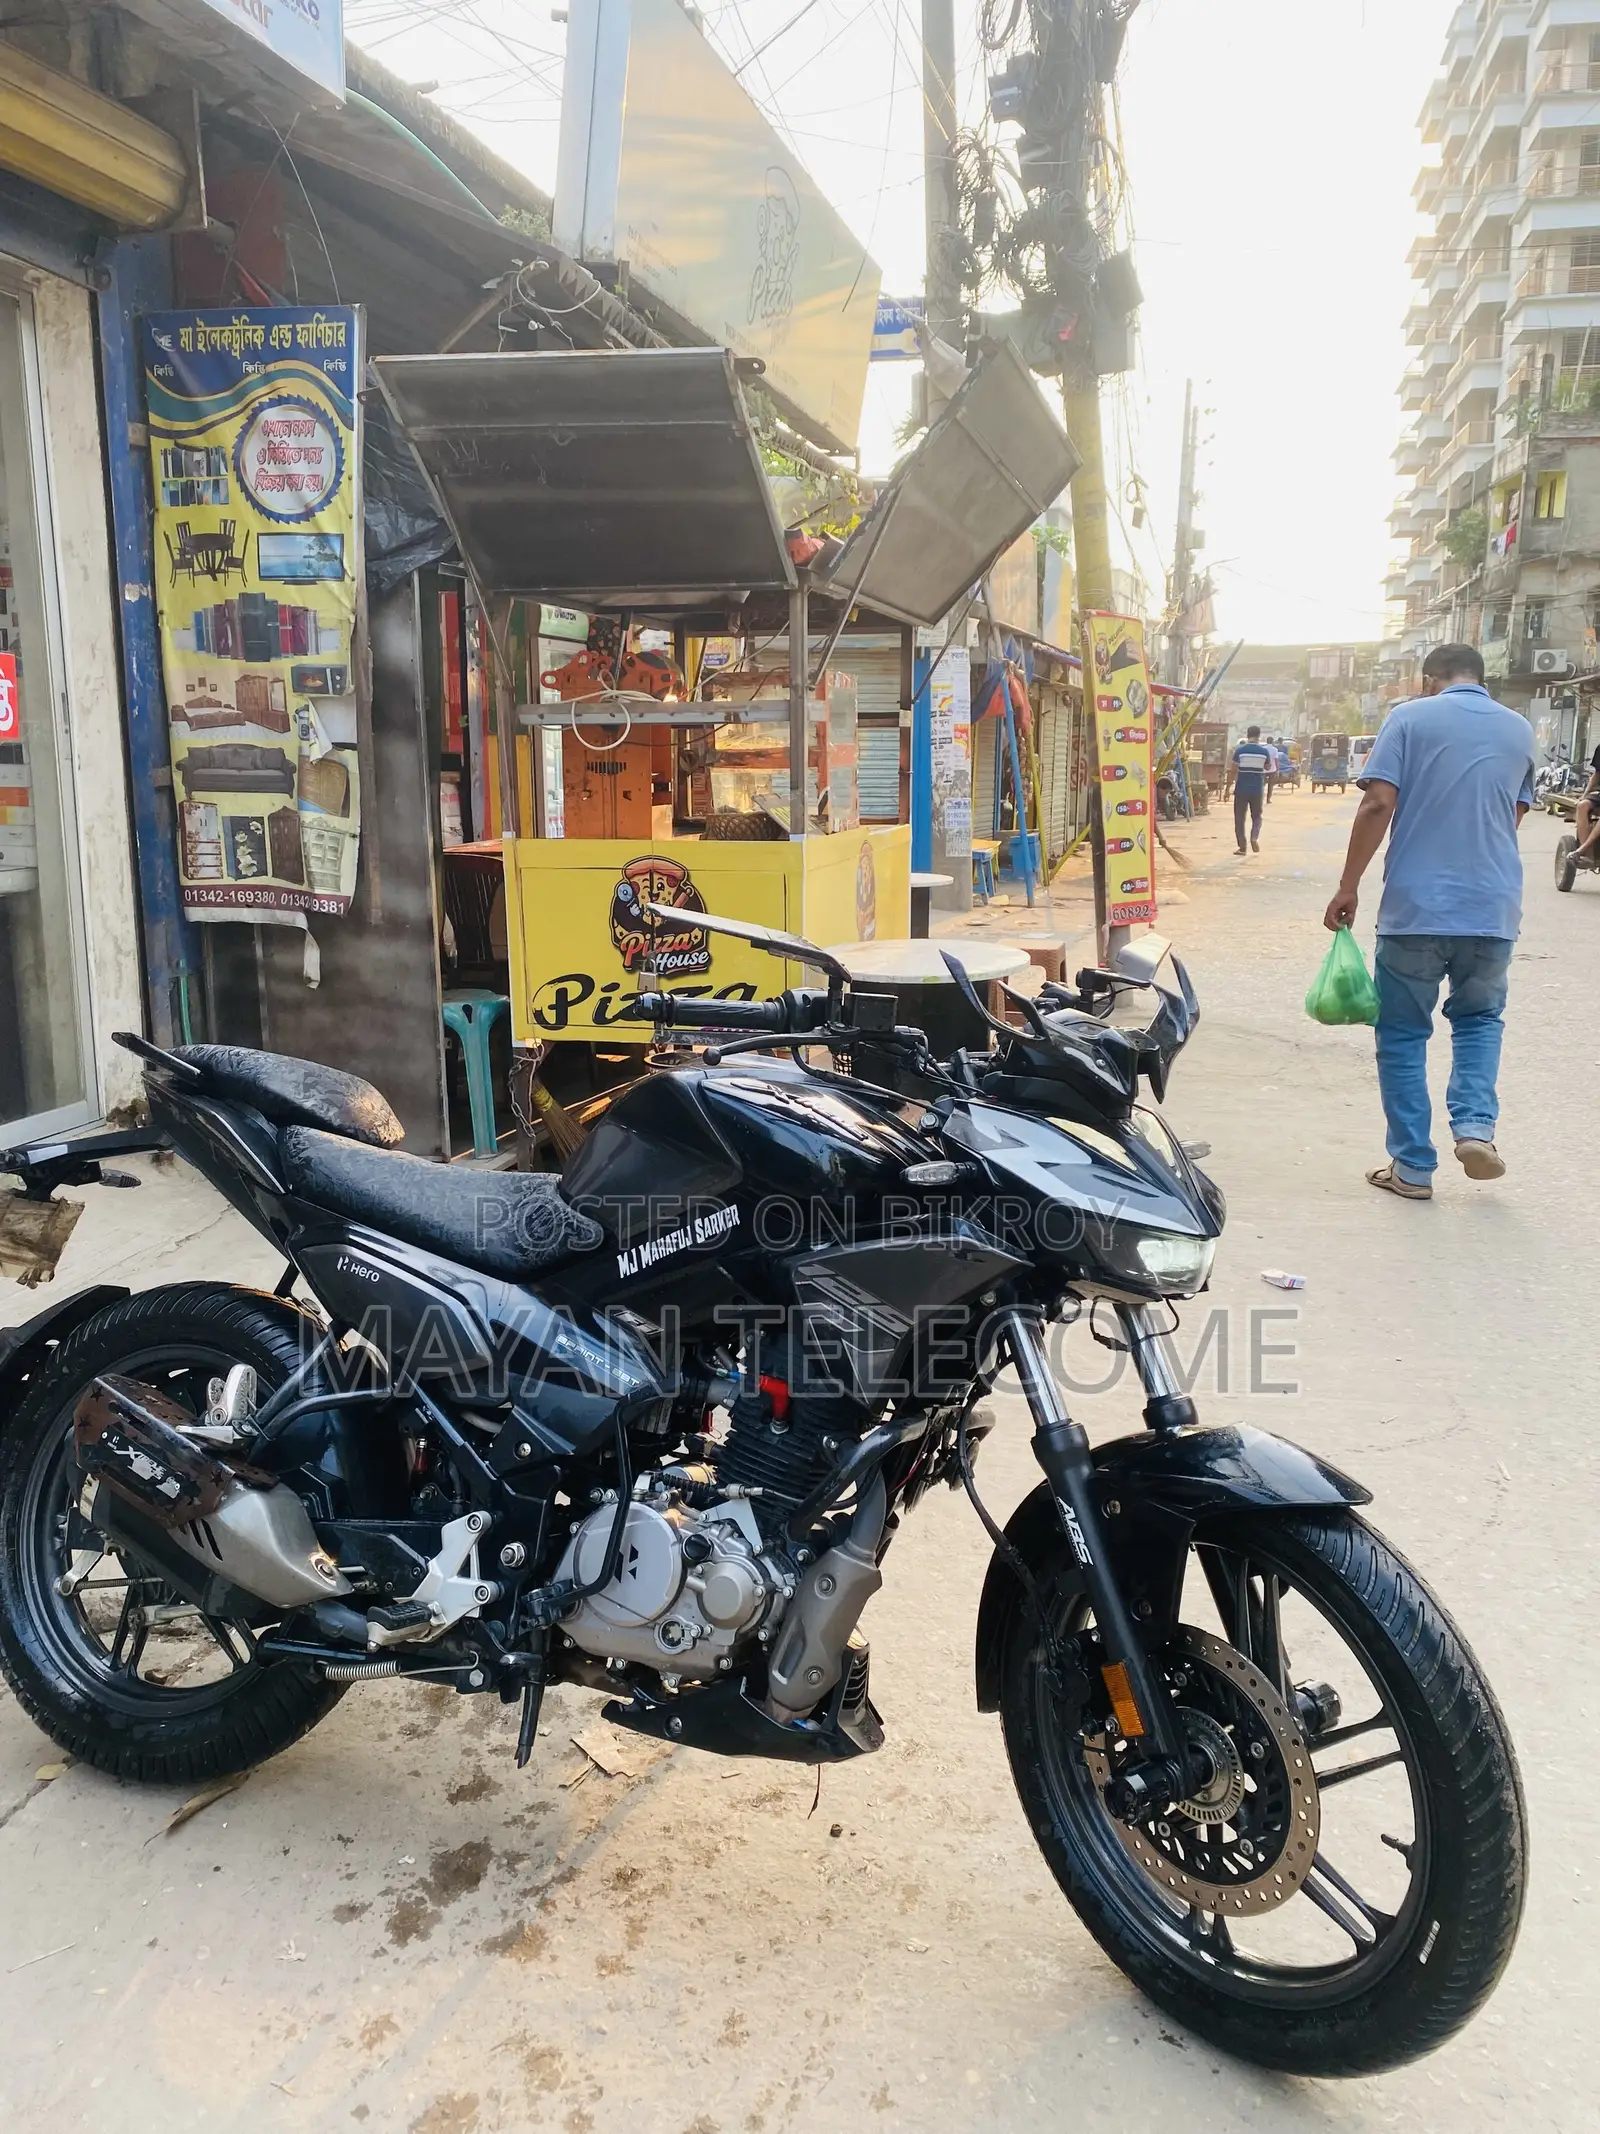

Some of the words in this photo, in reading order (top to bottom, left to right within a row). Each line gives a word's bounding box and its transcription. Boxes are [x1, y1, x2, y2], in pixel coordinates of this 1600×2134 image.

[180, 325, 193, 352] মা
[269, 324, 292, 350] এন্ড
[153, 365, 174, 377] কিস্তি
[242, 361, 266, 376] কিস্তি
[324, 358, 347, 372] কিস্তি
[262, 420, 292, 438] এখানে
[256, 448, 267, 465] ও
[656, 951, 709, 971] House
[617, 1249, 638, 1279] MJ
[1056, 1496, 1094, 1566] ABS
